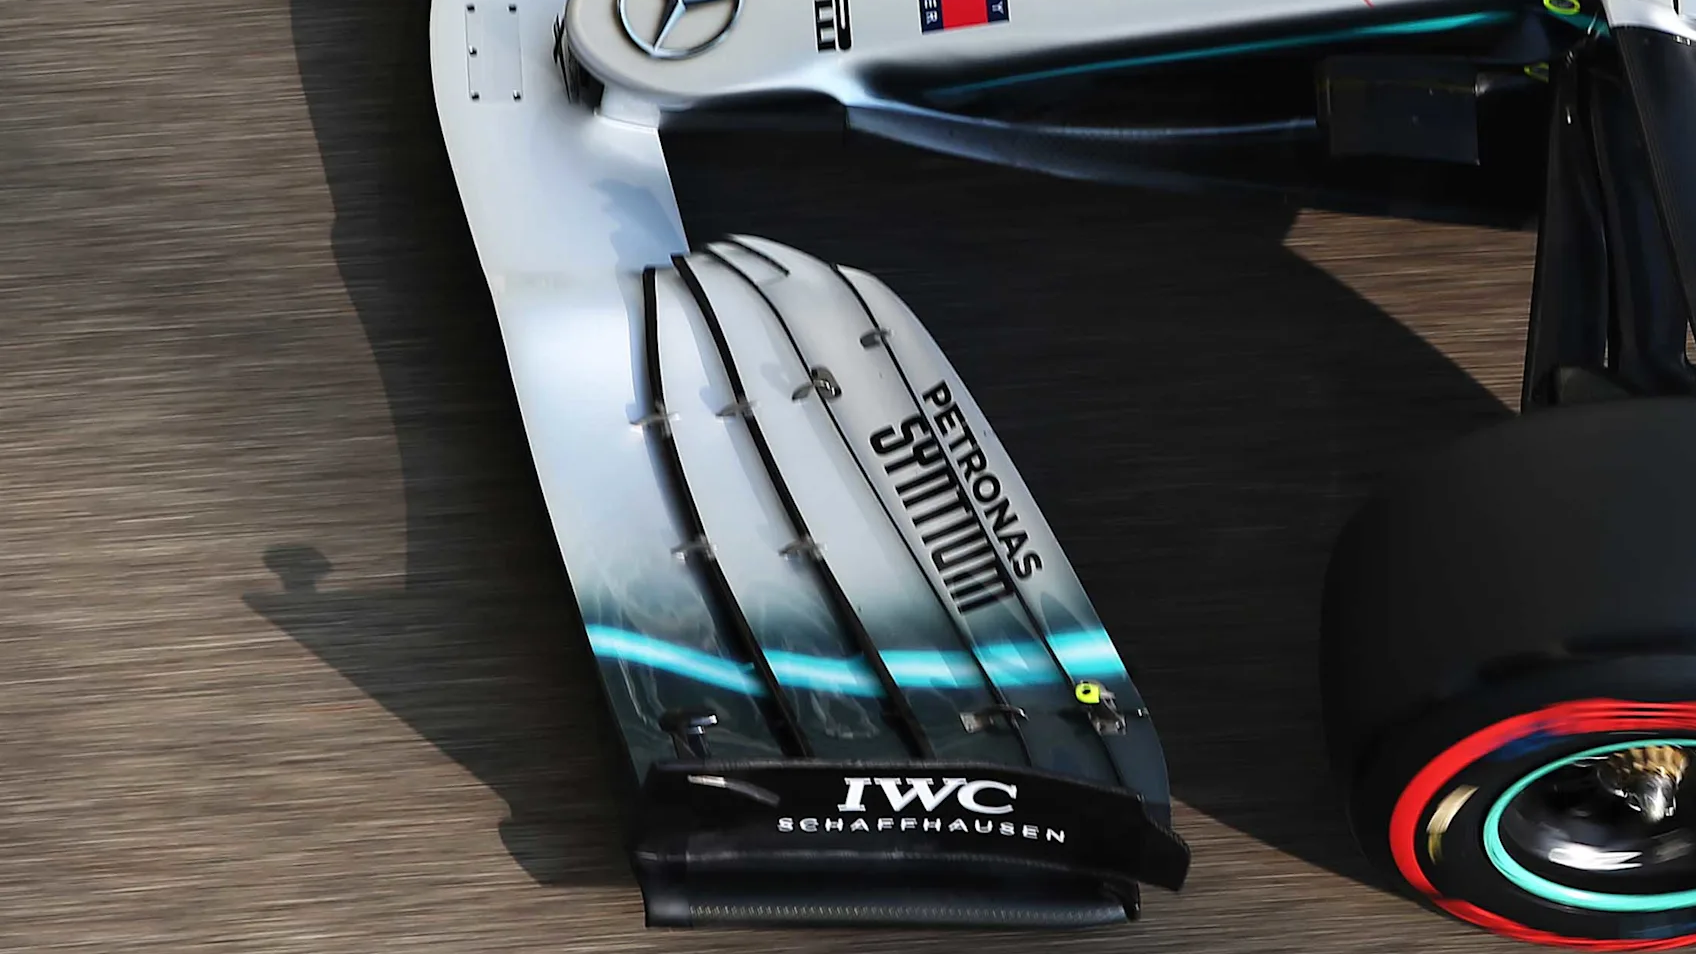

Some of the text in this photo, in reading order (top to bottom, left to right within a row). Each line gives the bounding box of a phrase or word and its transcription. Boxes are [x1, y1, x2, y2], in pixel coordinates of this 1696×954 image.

[868, 413, 1015, 615] SYNTIUM
[922, 379, 1044, 582] PETRONAS
[776, 816, 1067, 844] SCHAFFHAUSEN
[837, 777, 1018, 813] IWC
